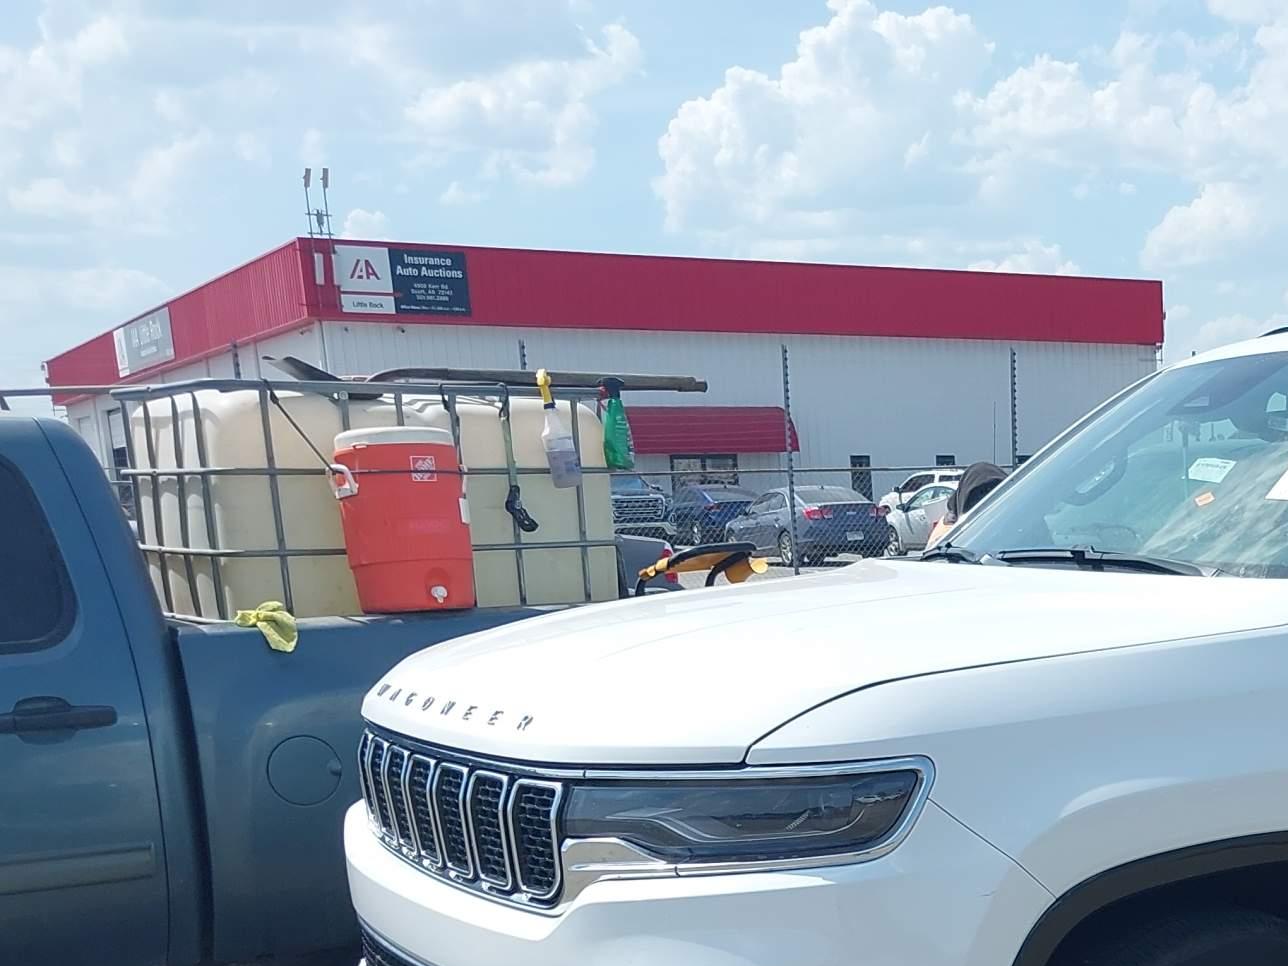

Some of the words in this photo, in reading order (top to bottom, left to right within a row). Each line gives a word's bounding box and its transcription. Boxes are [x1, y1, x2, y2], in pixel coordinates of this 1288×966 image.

[403, 253, 452, 266] Insurance
[396, 264, 419, 276] Auto
[420, 266, 463, 279] Auctions
[368, 301, 385, 309] Rock
[377, 683, 535, 731] WAGONEER
